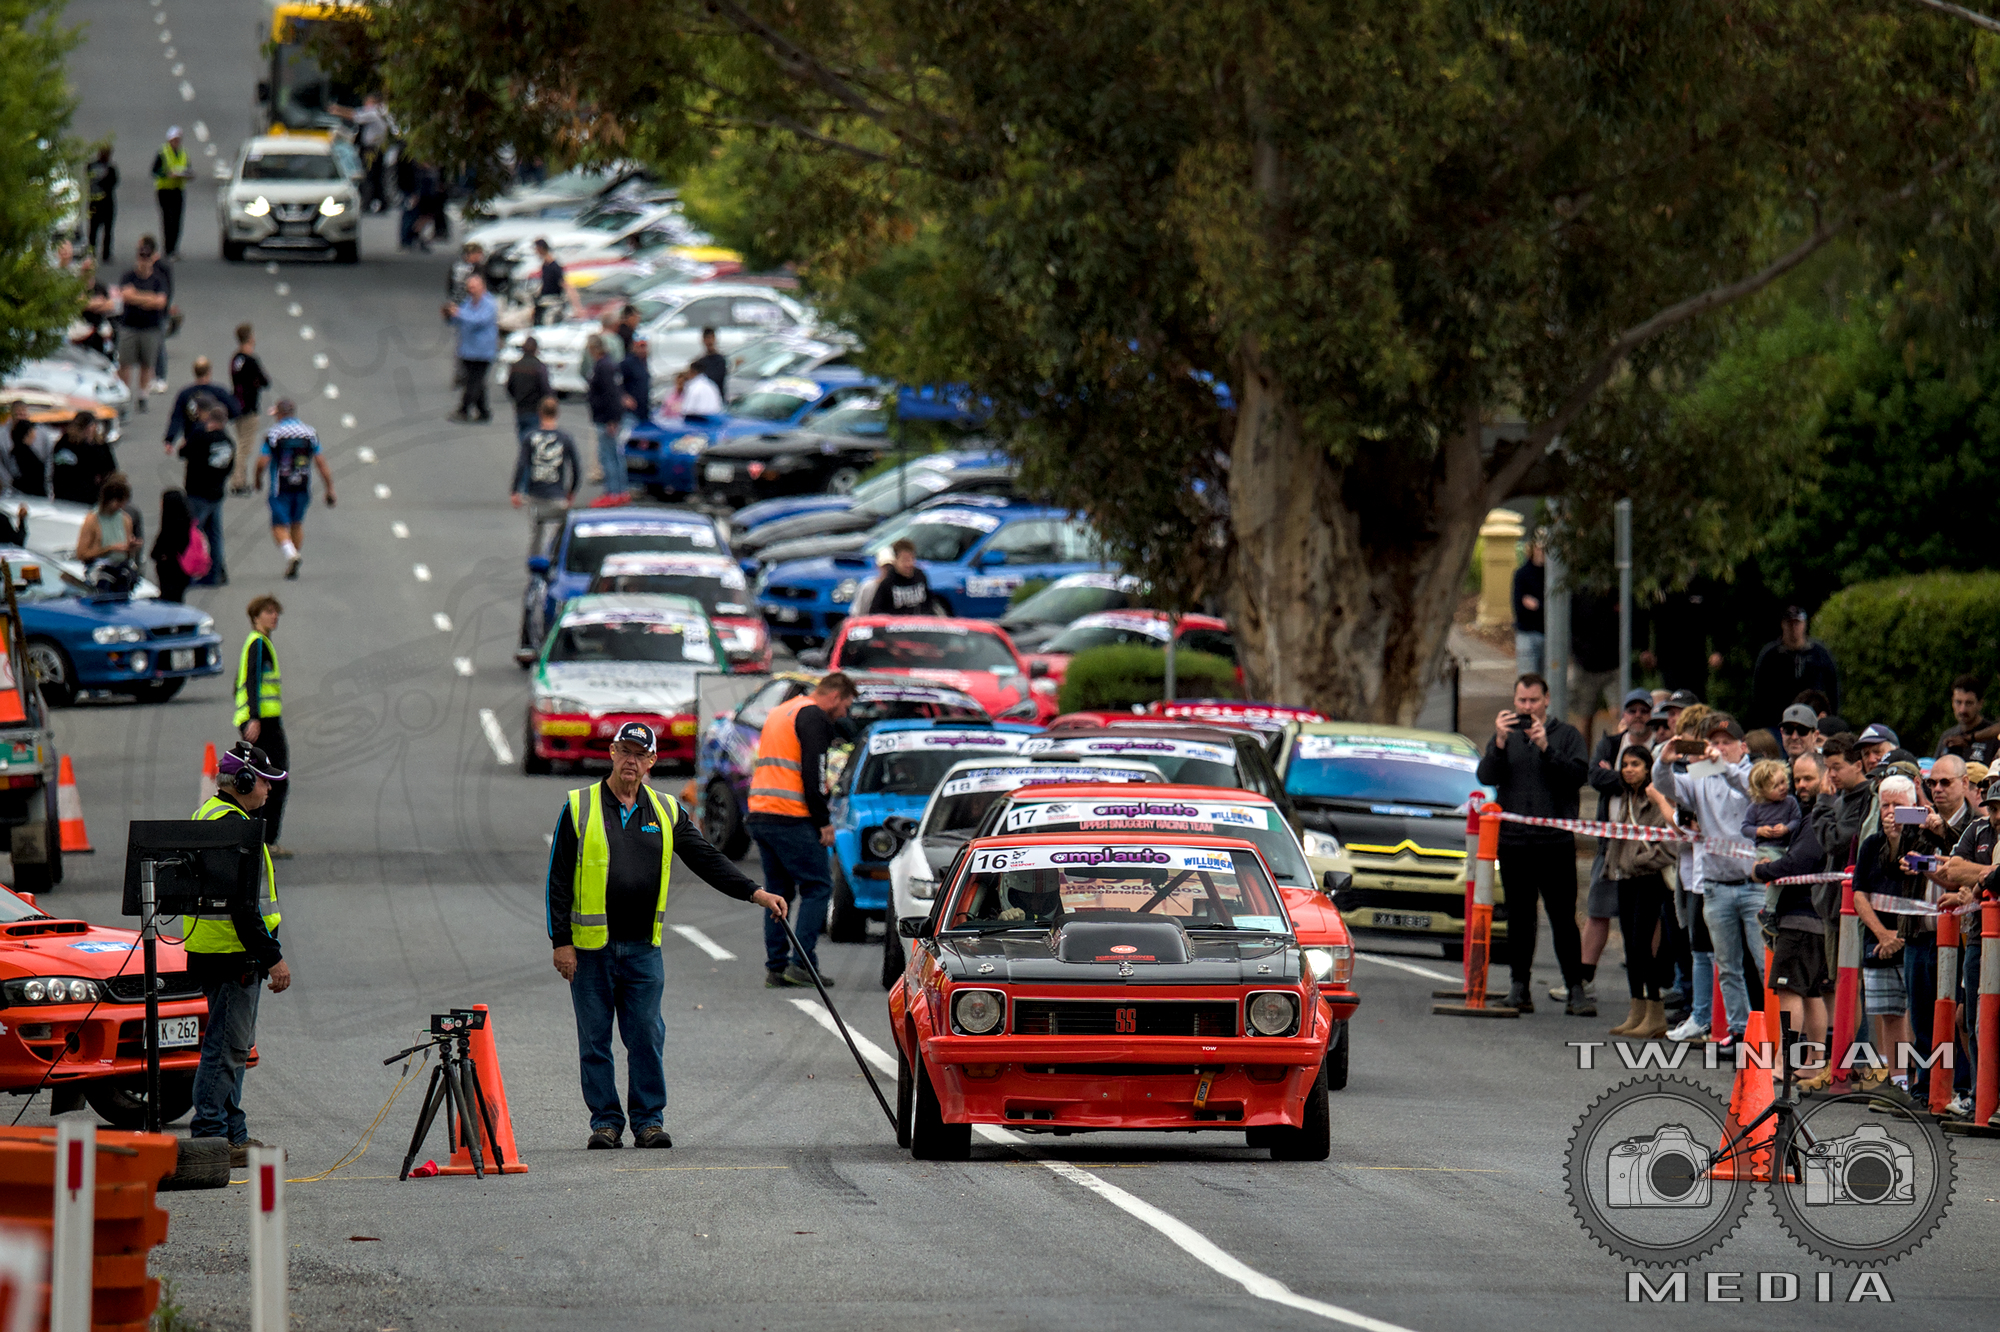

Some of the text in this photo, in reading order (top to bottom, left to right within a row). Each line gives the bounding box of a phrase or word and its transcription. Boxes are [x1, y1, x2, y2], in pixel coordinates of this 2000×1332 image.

[1011, 809, 1037, 826] 17
[1079, 820, 1214, 832] UPPER SNUGGERY RACING TEAM
[978, 854, 1009, 870] 16
[1183, 857, 1234, 870] WILLUNGA
[1115, 1008, 1137, 1033] SS
[177, 1021, 197, 1039] 262
